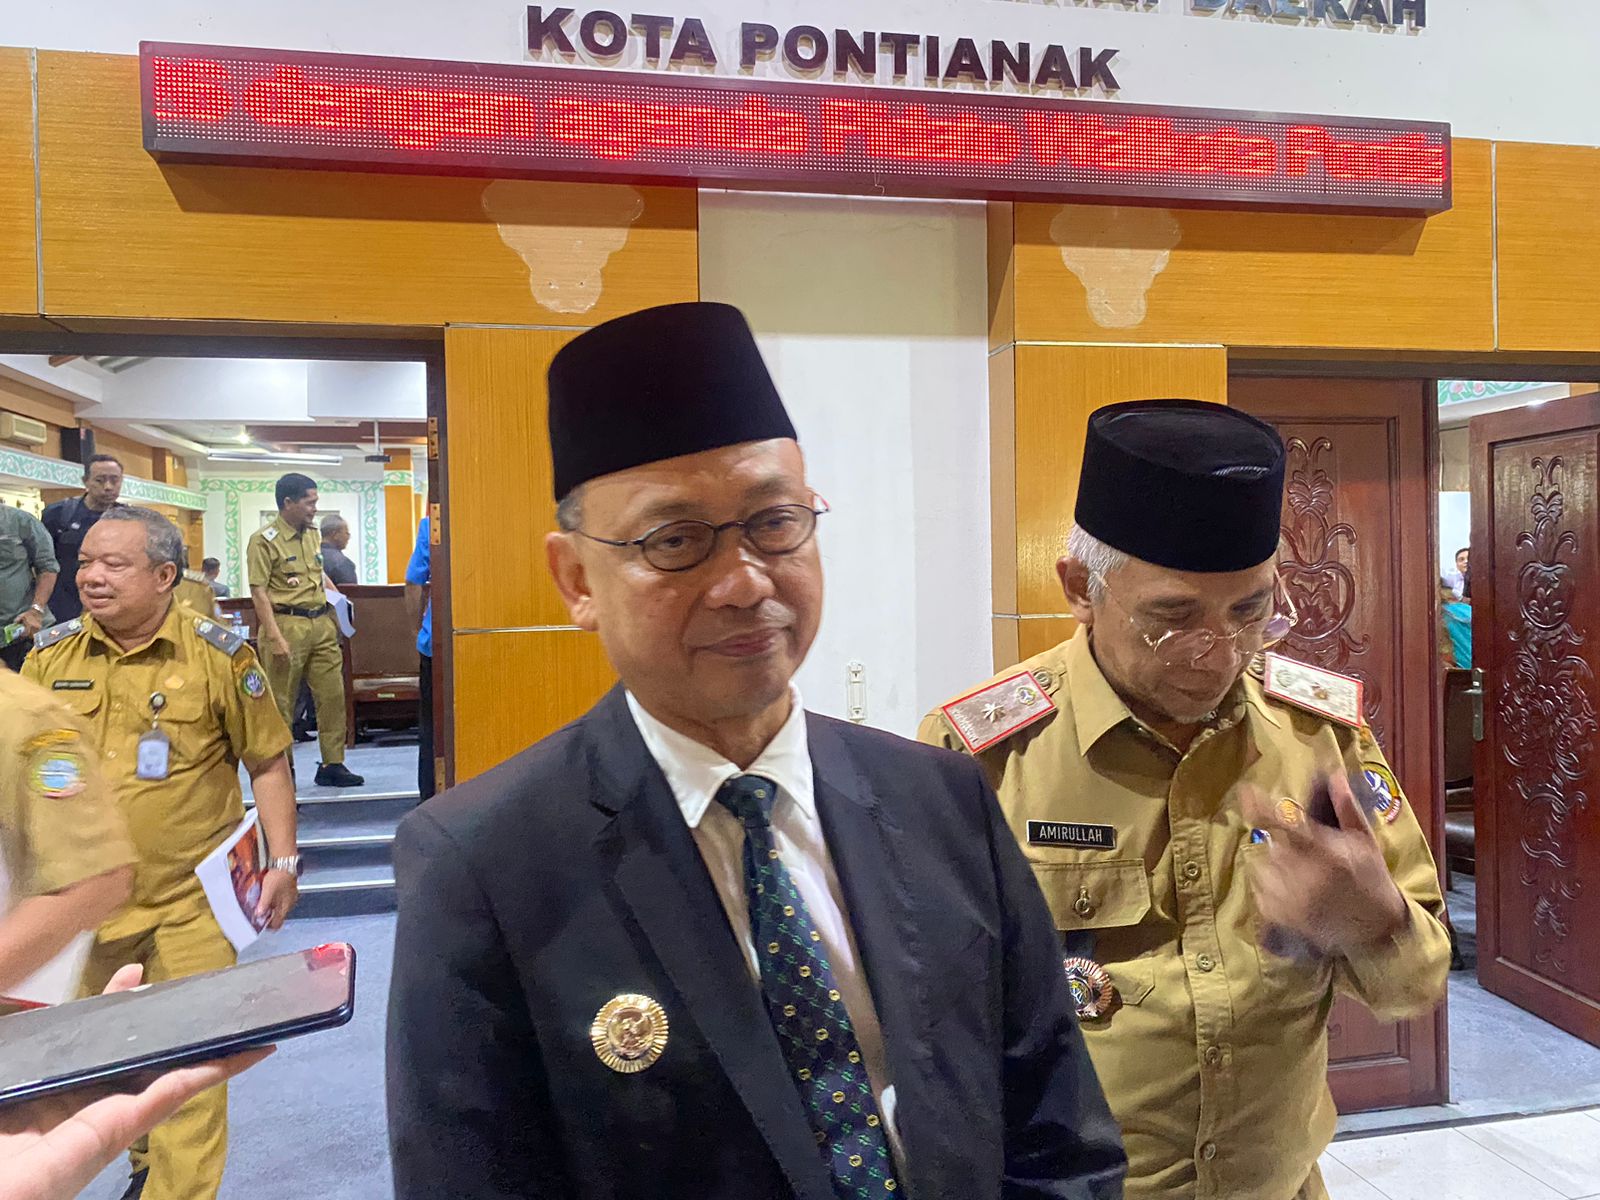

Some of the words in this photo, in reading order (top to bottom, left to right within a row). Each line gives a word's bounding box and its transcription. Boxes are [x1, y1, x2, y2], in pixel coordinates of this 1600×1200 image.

[527, 5, 718, 64] KOTA
[740, 22, 1121, 90] PONTIANAK
[244, 65, 534, 148] dengan
[547, 95, 809, 158] agenda
[1039, 825, 1103, 843] AMIRULLAH
